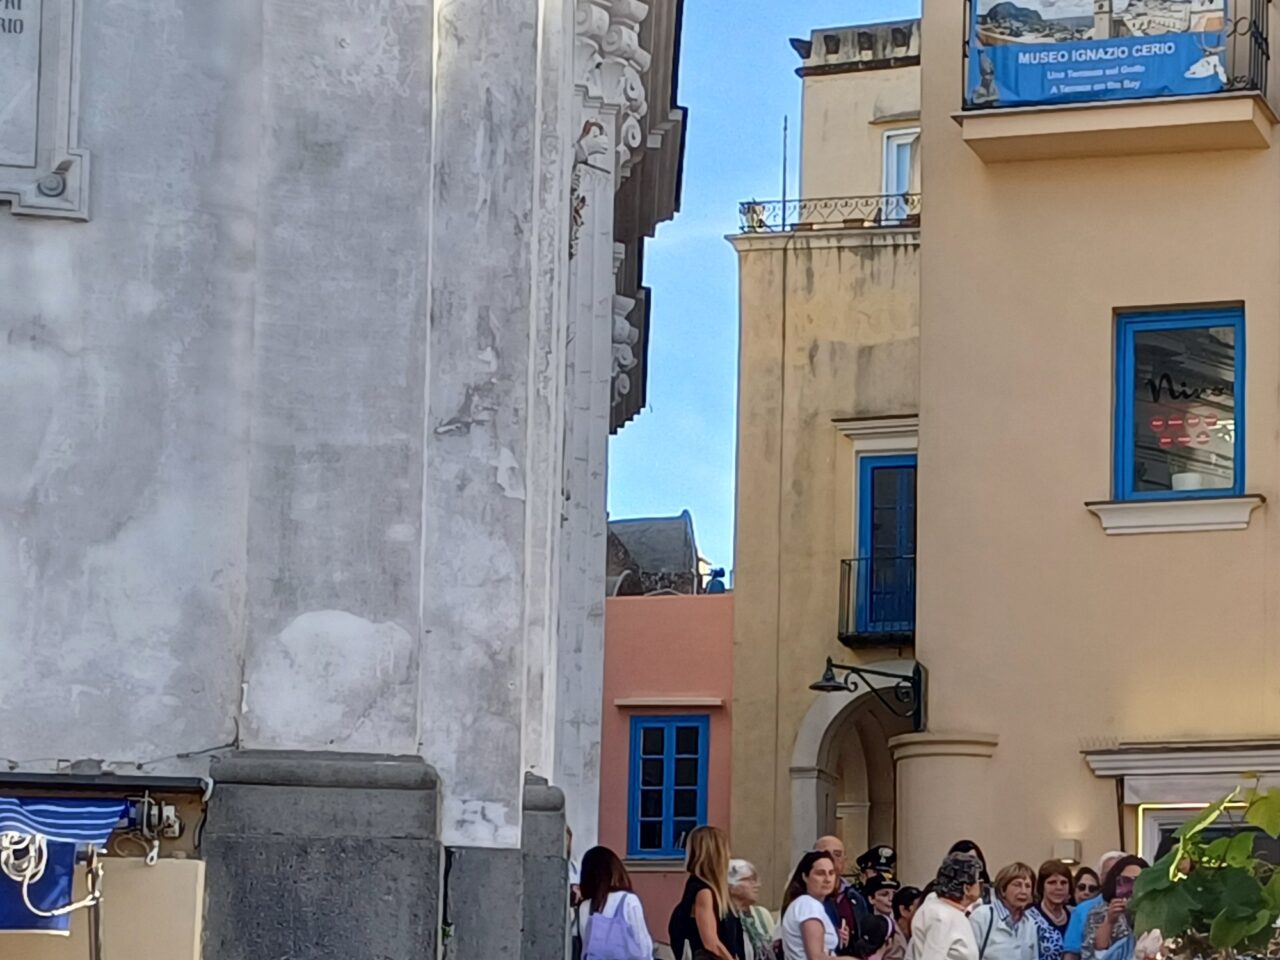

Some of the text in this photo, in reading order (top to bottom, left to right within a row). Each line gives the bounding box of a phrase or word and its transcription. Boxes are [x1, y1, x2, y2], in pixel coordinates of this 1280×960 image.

[1018, 42, 1175, 64] MUSEO IGNAZIO CERIO
